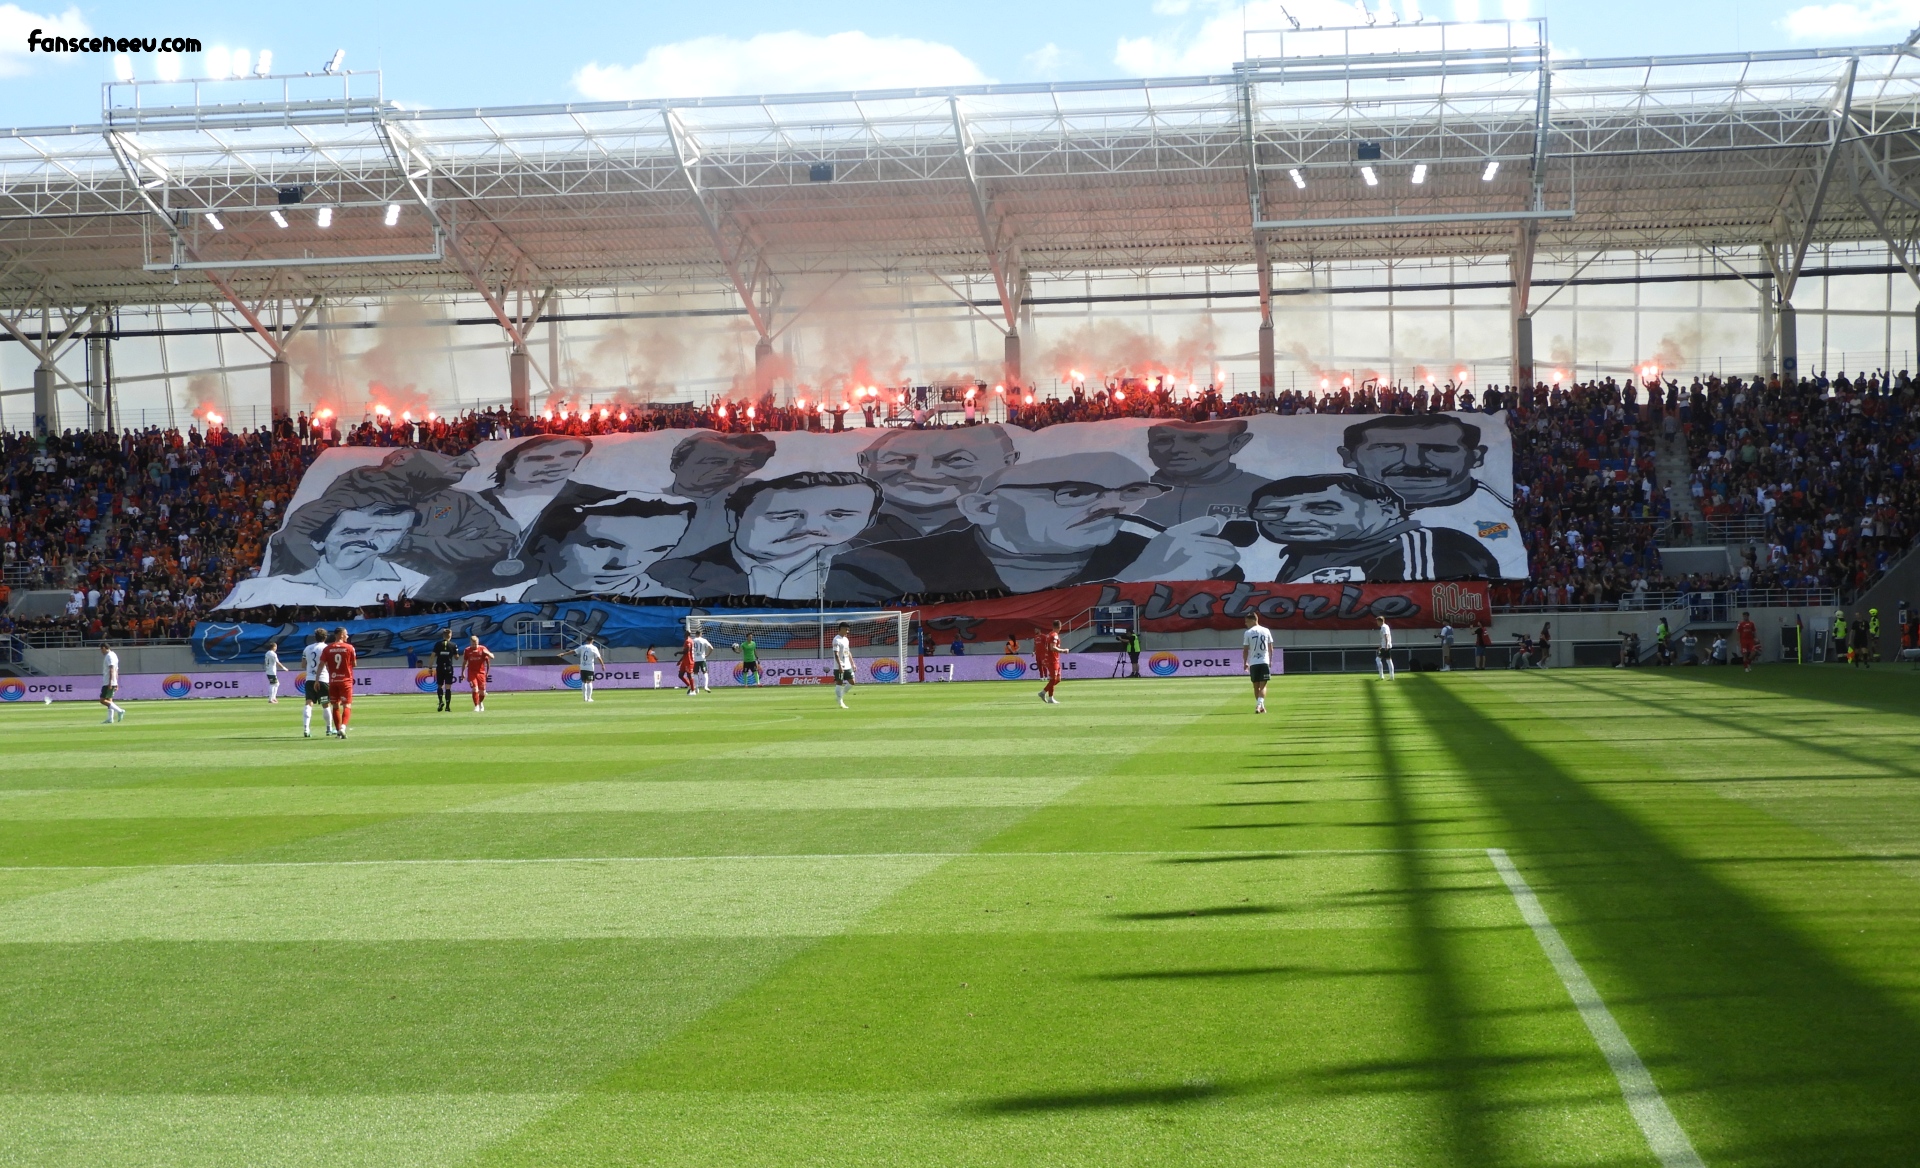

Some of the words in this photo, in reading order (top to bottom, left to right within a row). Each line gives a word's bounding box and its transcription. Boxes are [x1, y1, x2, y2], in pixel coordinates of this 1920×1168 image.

[1093, 584, 1418, 621] historie
[1251, 635, 1266, 651] 78
[311, 651, 317, 669] 3
[583, 650, 588, 661] 6
[334, 653, 342, 669] 9
[1183, 659, 1231, 668] OPOLE
[1029, 662, 1077, 671] OLE
[594, 671, 640, 681] OPOLE
[766, 667, 813, 677] OPOLE
[194, 680, 239, 690] OPOLE
[792, 677, 822, 685] Betclic
[28, 684, 73, 693] OPOLE
